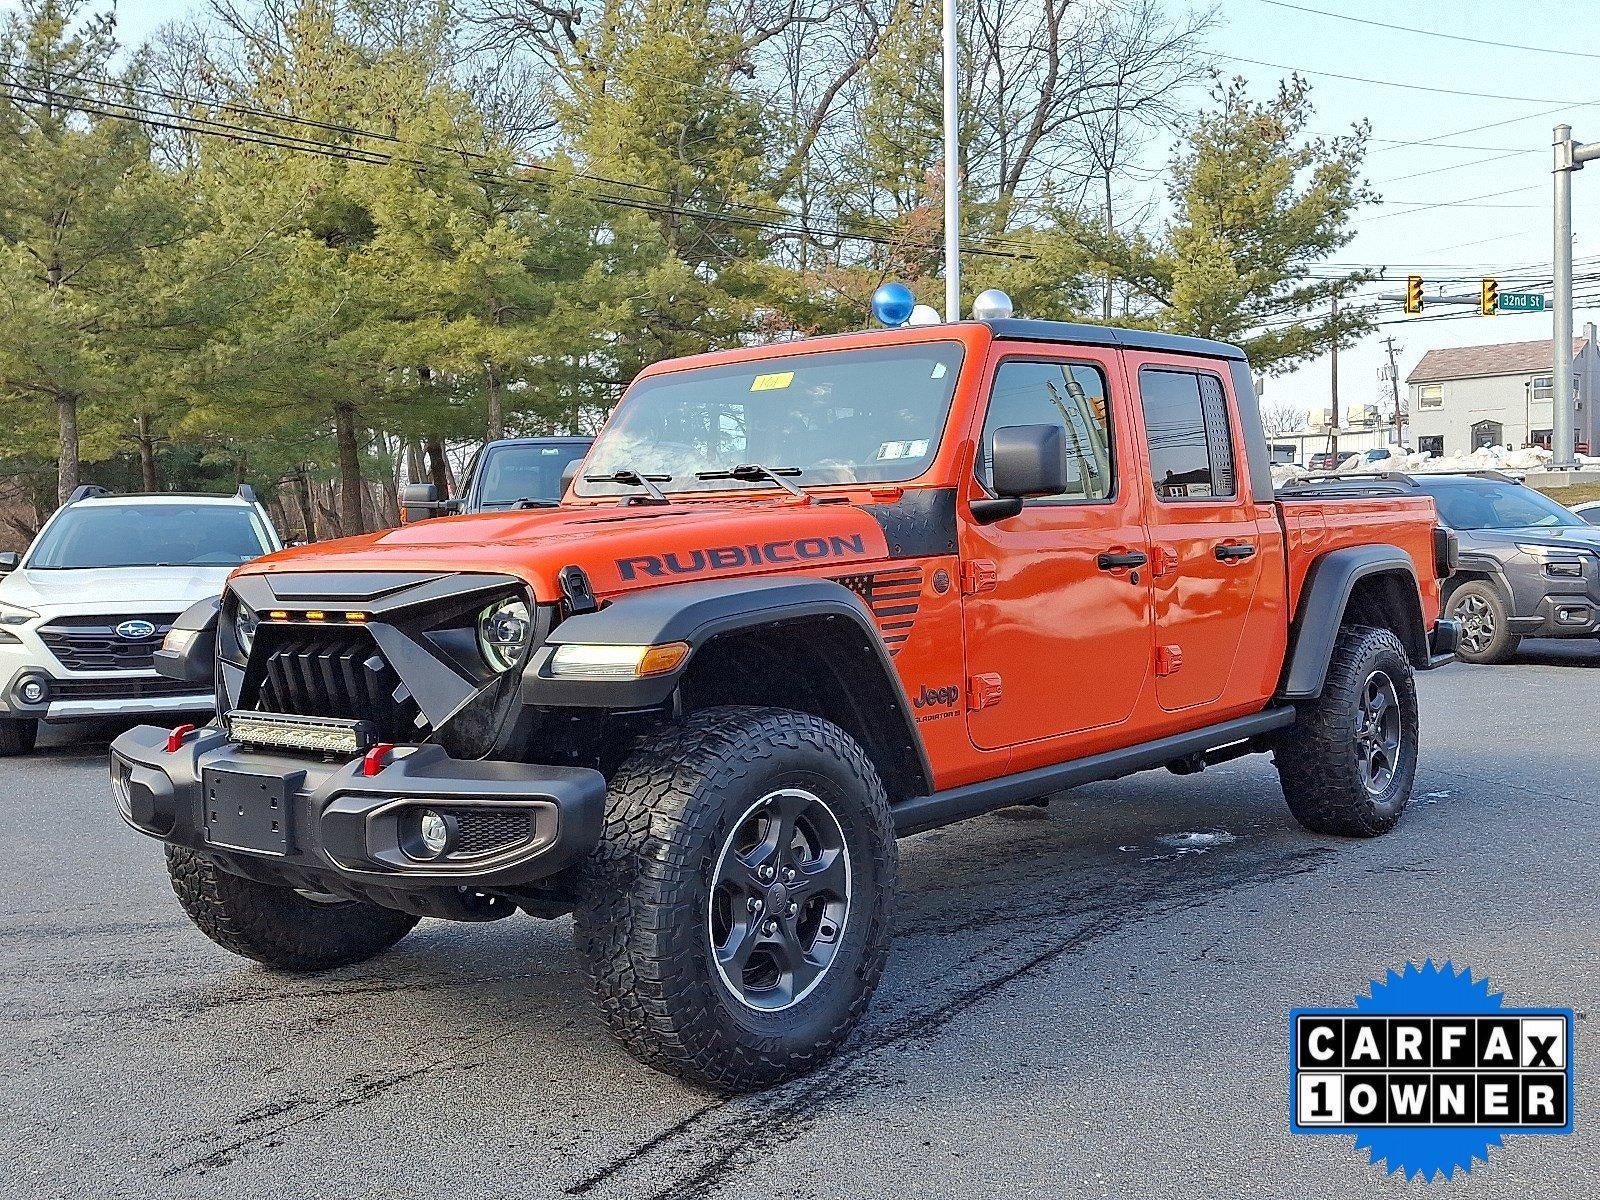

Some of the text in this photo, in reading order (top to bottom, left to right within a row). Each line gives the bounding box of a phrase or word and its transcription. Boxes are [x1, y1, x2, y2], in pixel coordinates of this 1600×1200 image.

[1503, 295, 1540, 307] 32nd St
[614, 534, 866, 581] RUBICON
[913, 684, 959, 708] Jeep
